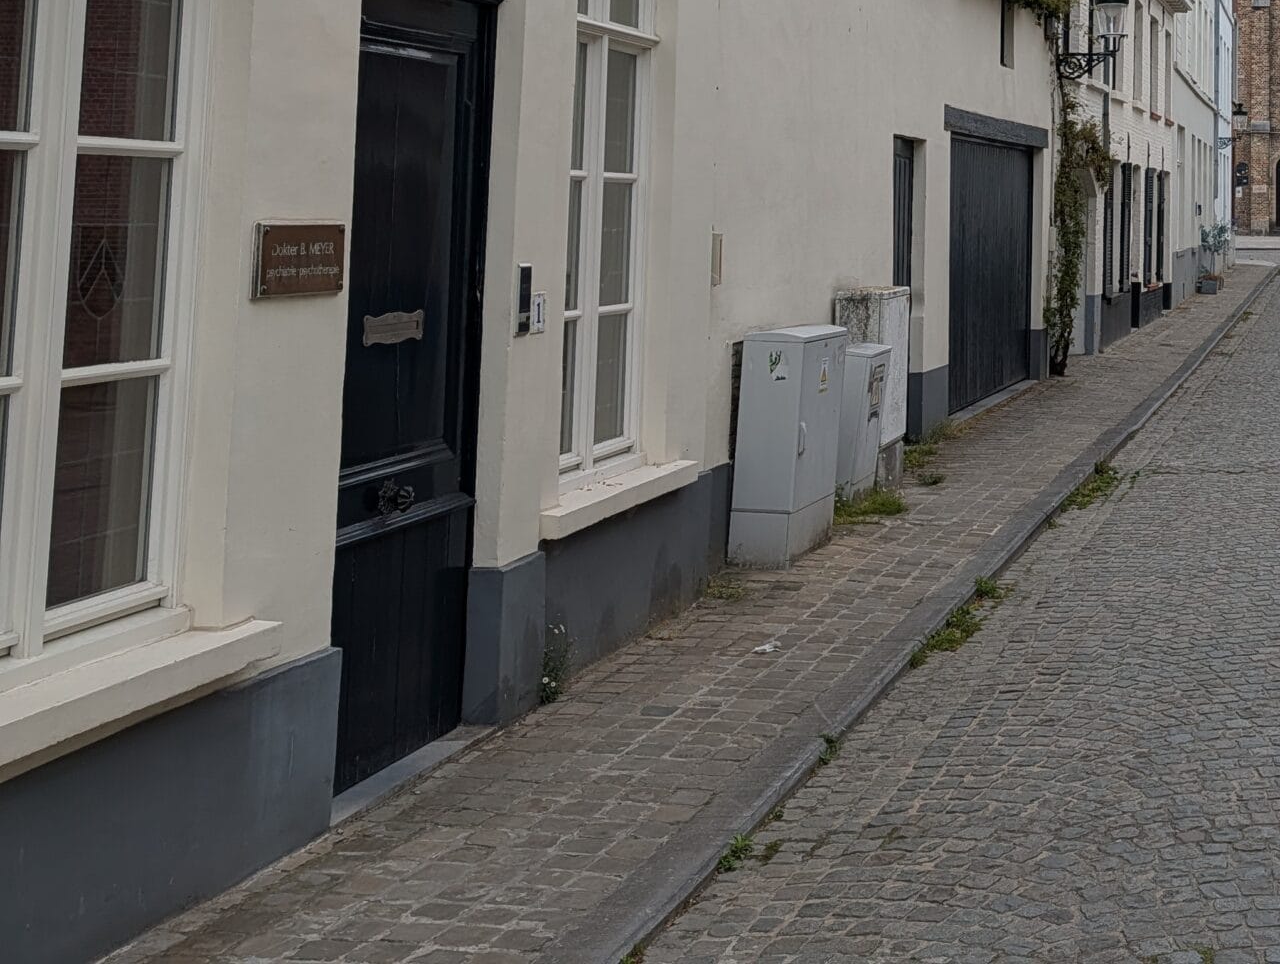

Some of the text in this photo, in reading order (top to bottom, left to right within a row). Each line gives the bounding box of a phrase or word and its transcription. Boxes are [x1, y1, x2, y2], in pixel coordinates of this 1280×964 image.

[271, 242, 299, 255] Dokter
[309, 241, 335, 255] MEYER
[536, 302, 541, 323] 1
